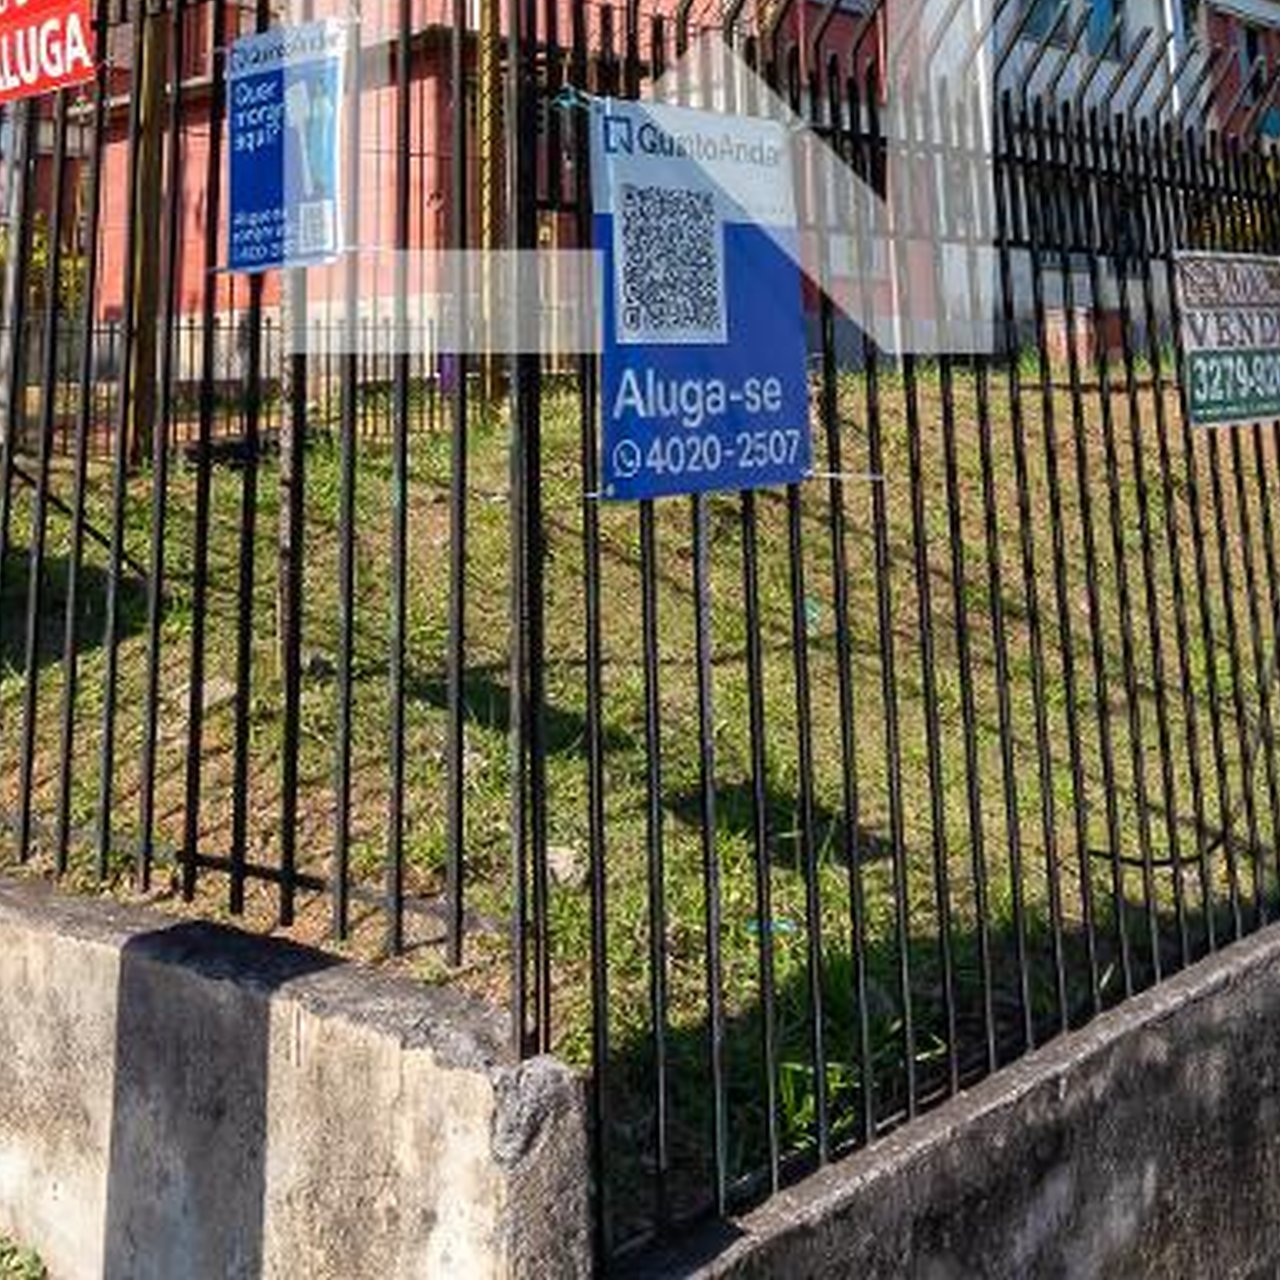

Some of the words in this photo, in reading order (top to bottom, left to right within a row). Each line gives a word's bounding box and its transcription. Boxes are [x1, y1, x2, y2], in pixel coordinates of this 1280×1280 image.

[638, 122, 782, 168] QuintoAnda
[613, 367, 783, 428] Aluga-se
[644, 429, 801, 475] 4020-2507
